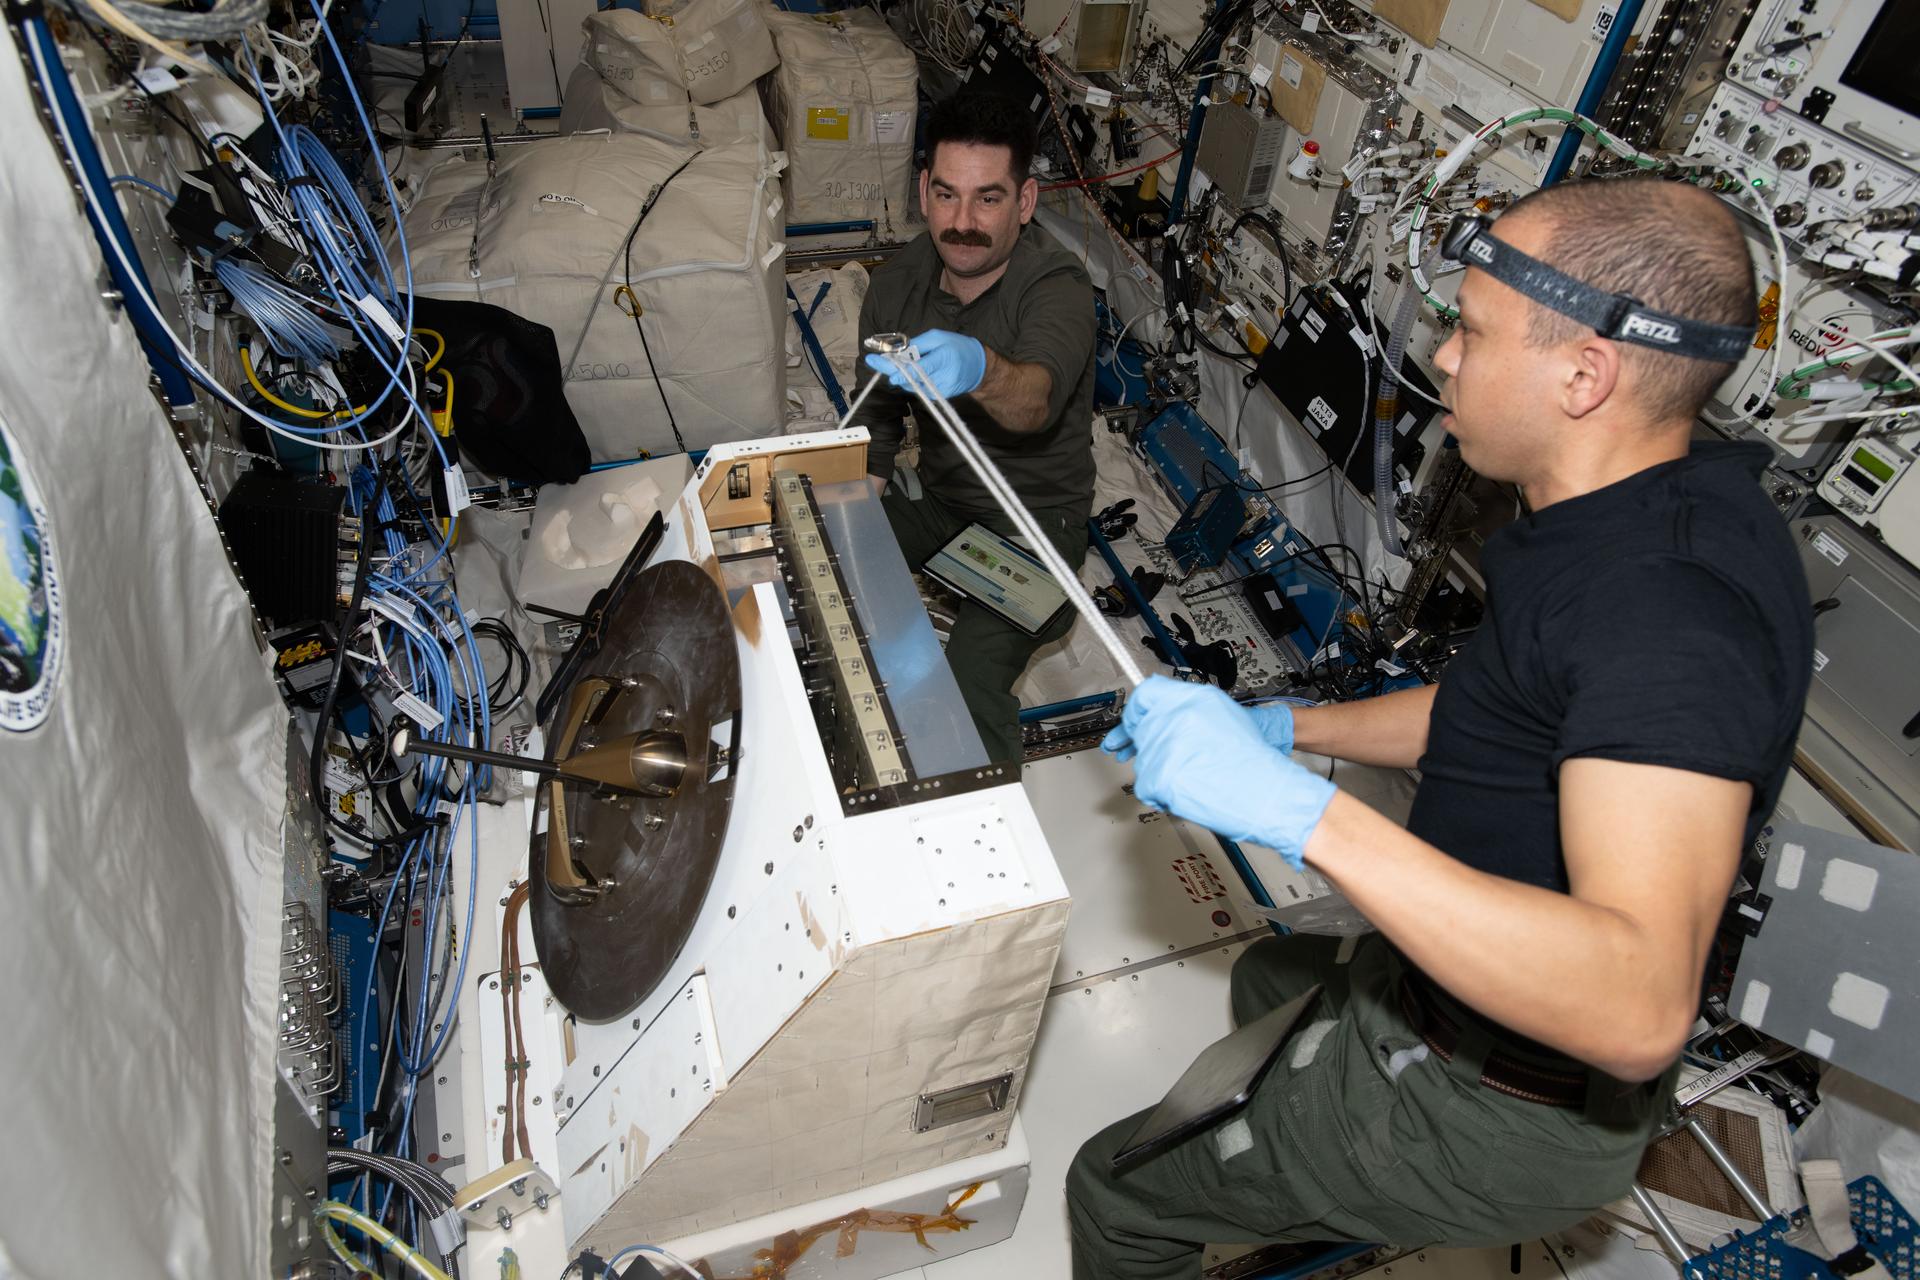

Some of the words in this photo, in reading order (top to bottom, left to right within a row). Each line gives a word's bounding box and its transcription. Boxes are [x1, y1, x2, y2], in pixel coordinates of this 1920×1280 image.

[1468, 238, 1494, 264] ETZL
[1524, 271, 1579, 305] TIKKA
[1621, 314, 1682, 344] PETZL
[1788, 328, 1854, 374] REDWE
[1312, 407, 1329, 427] JAXA
[1316, 399, 1333, 419] PLT3
[1187, 861, 1202, 880] PORT
[1199, 879, 1211, 895] FIRE
